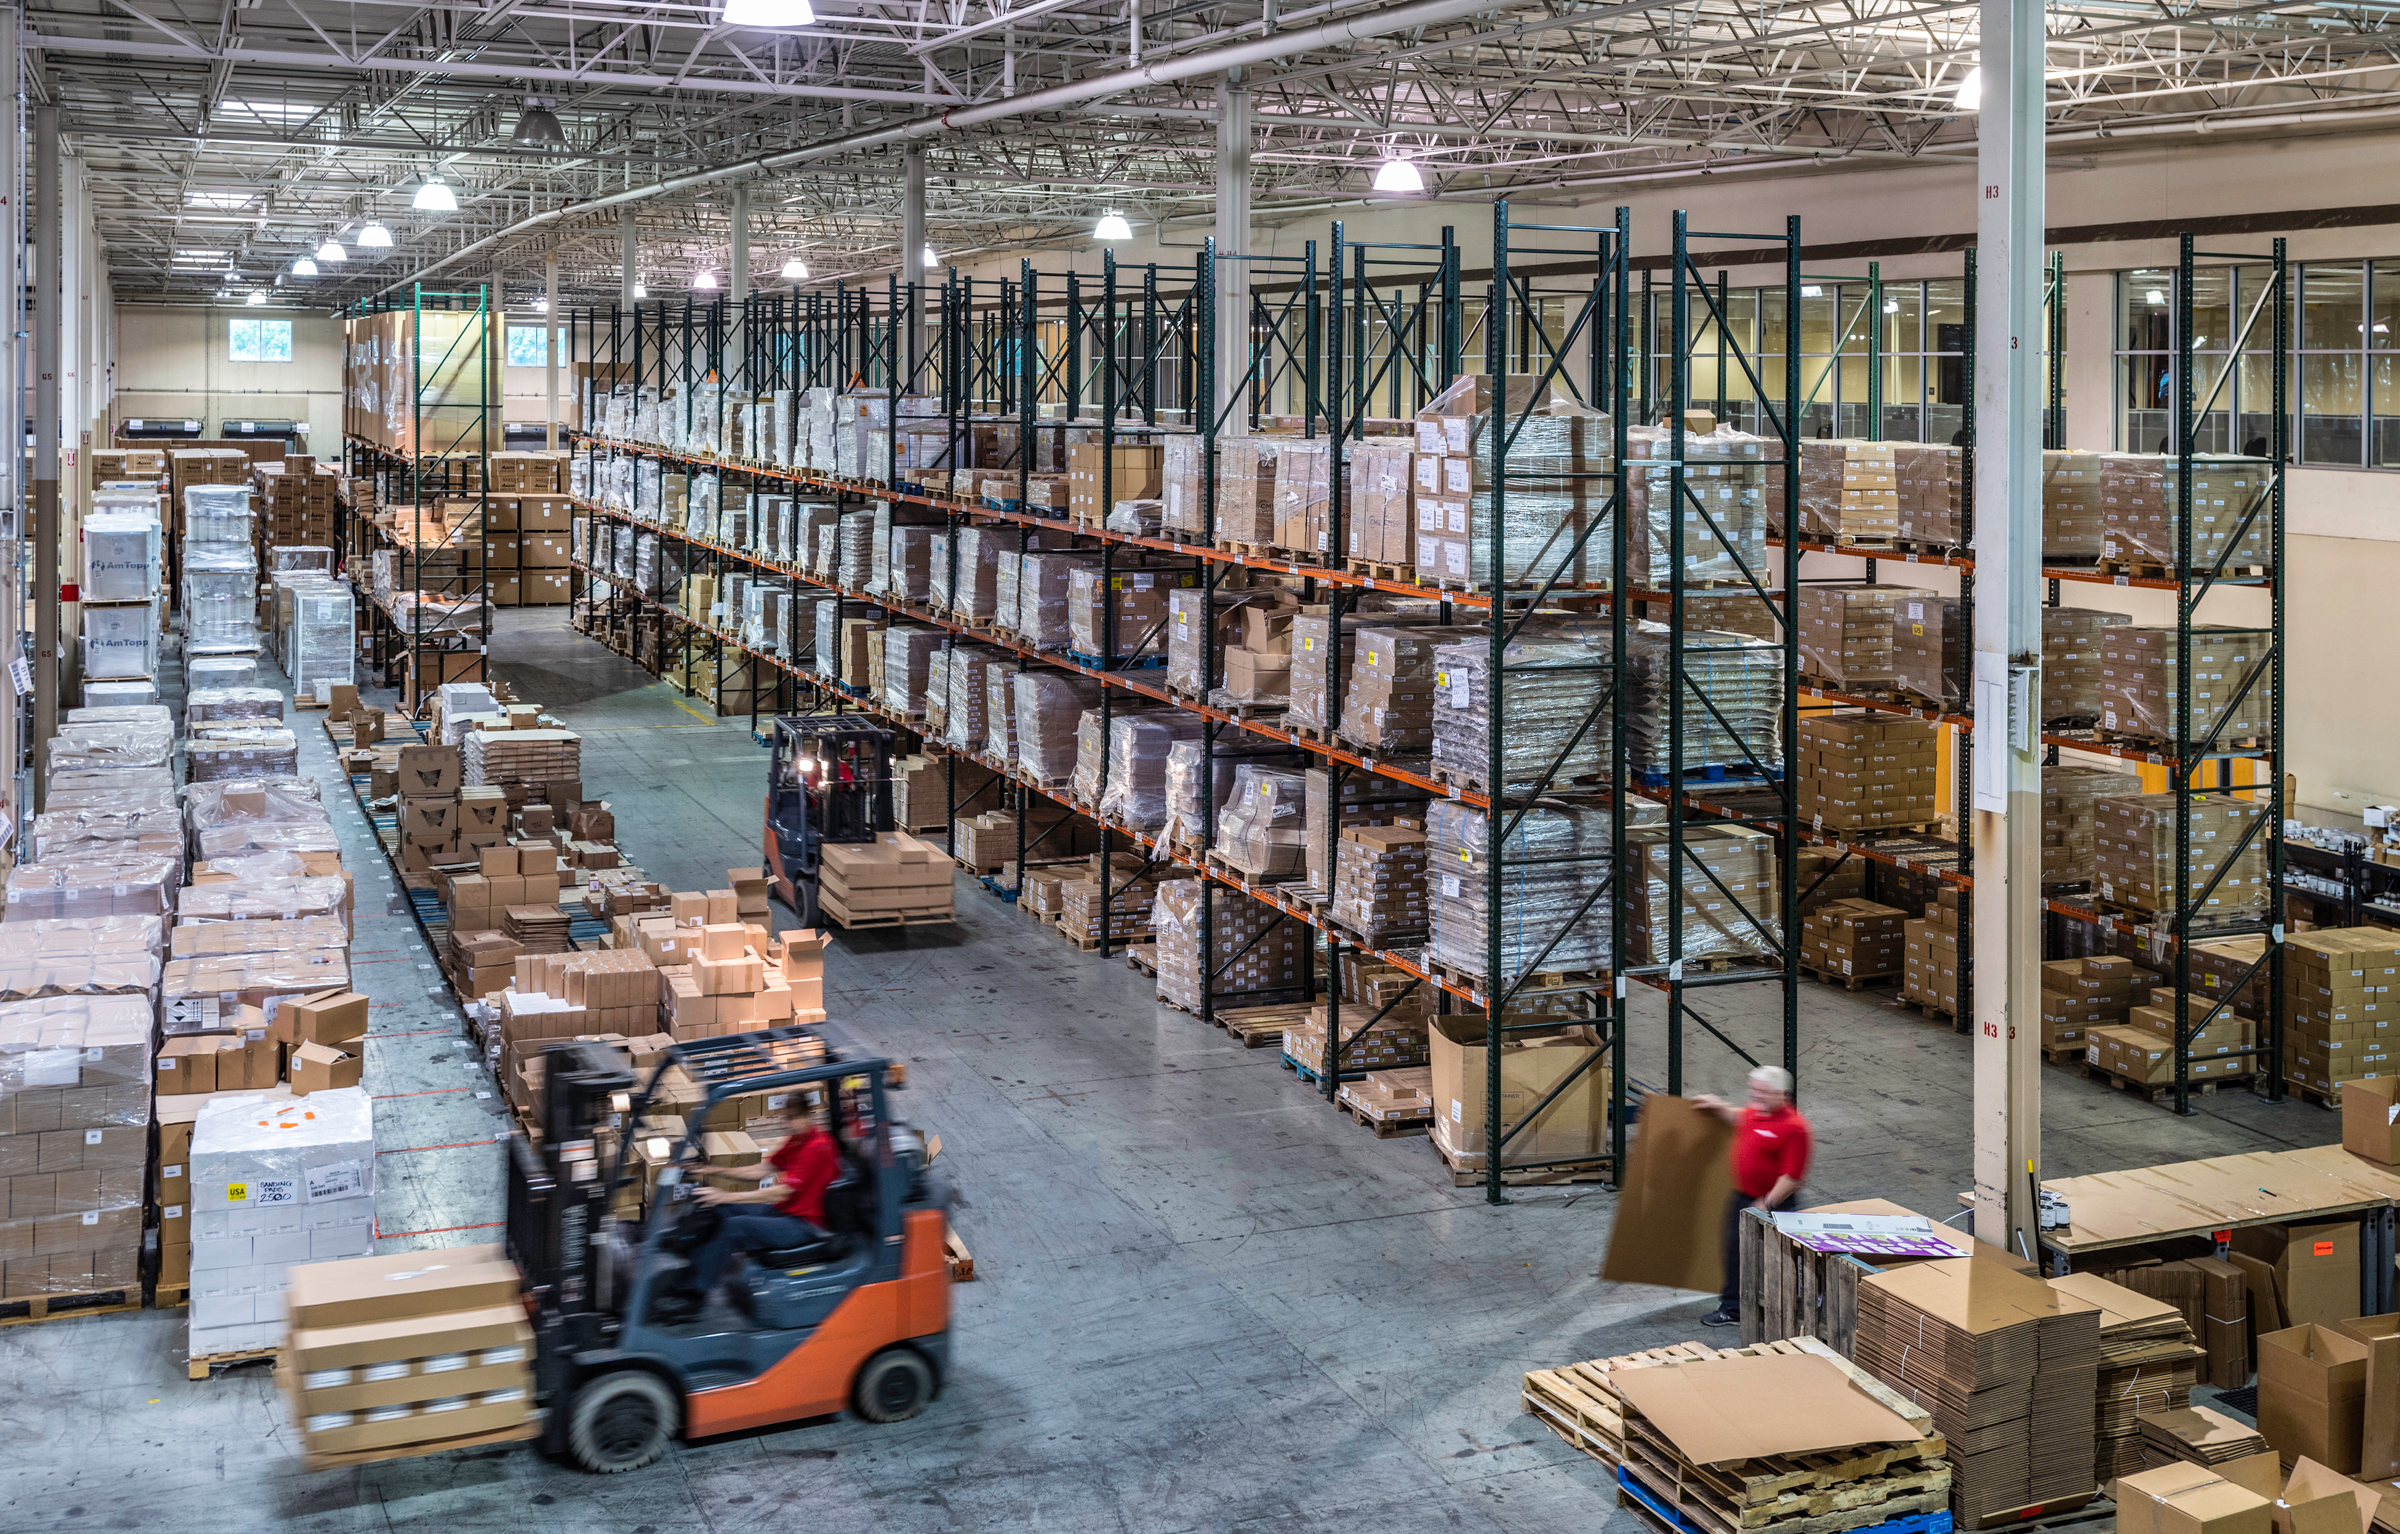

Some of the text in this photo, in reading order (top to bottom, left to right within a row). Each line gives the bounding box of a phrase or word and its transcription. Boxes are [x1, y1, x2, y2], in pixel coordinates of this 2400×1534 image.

[1986, 185, 1999, 199] H3
[106, 561, 150, 571] AmTopp
[105, 639, 149, 647] AmTopp
[41, 650, 52, 658] G5
[1984, 1021, 1998, 1039] H3
[259, 1180, 293, 1188] SANDING
[230, 1188, 245, 1196] USA
